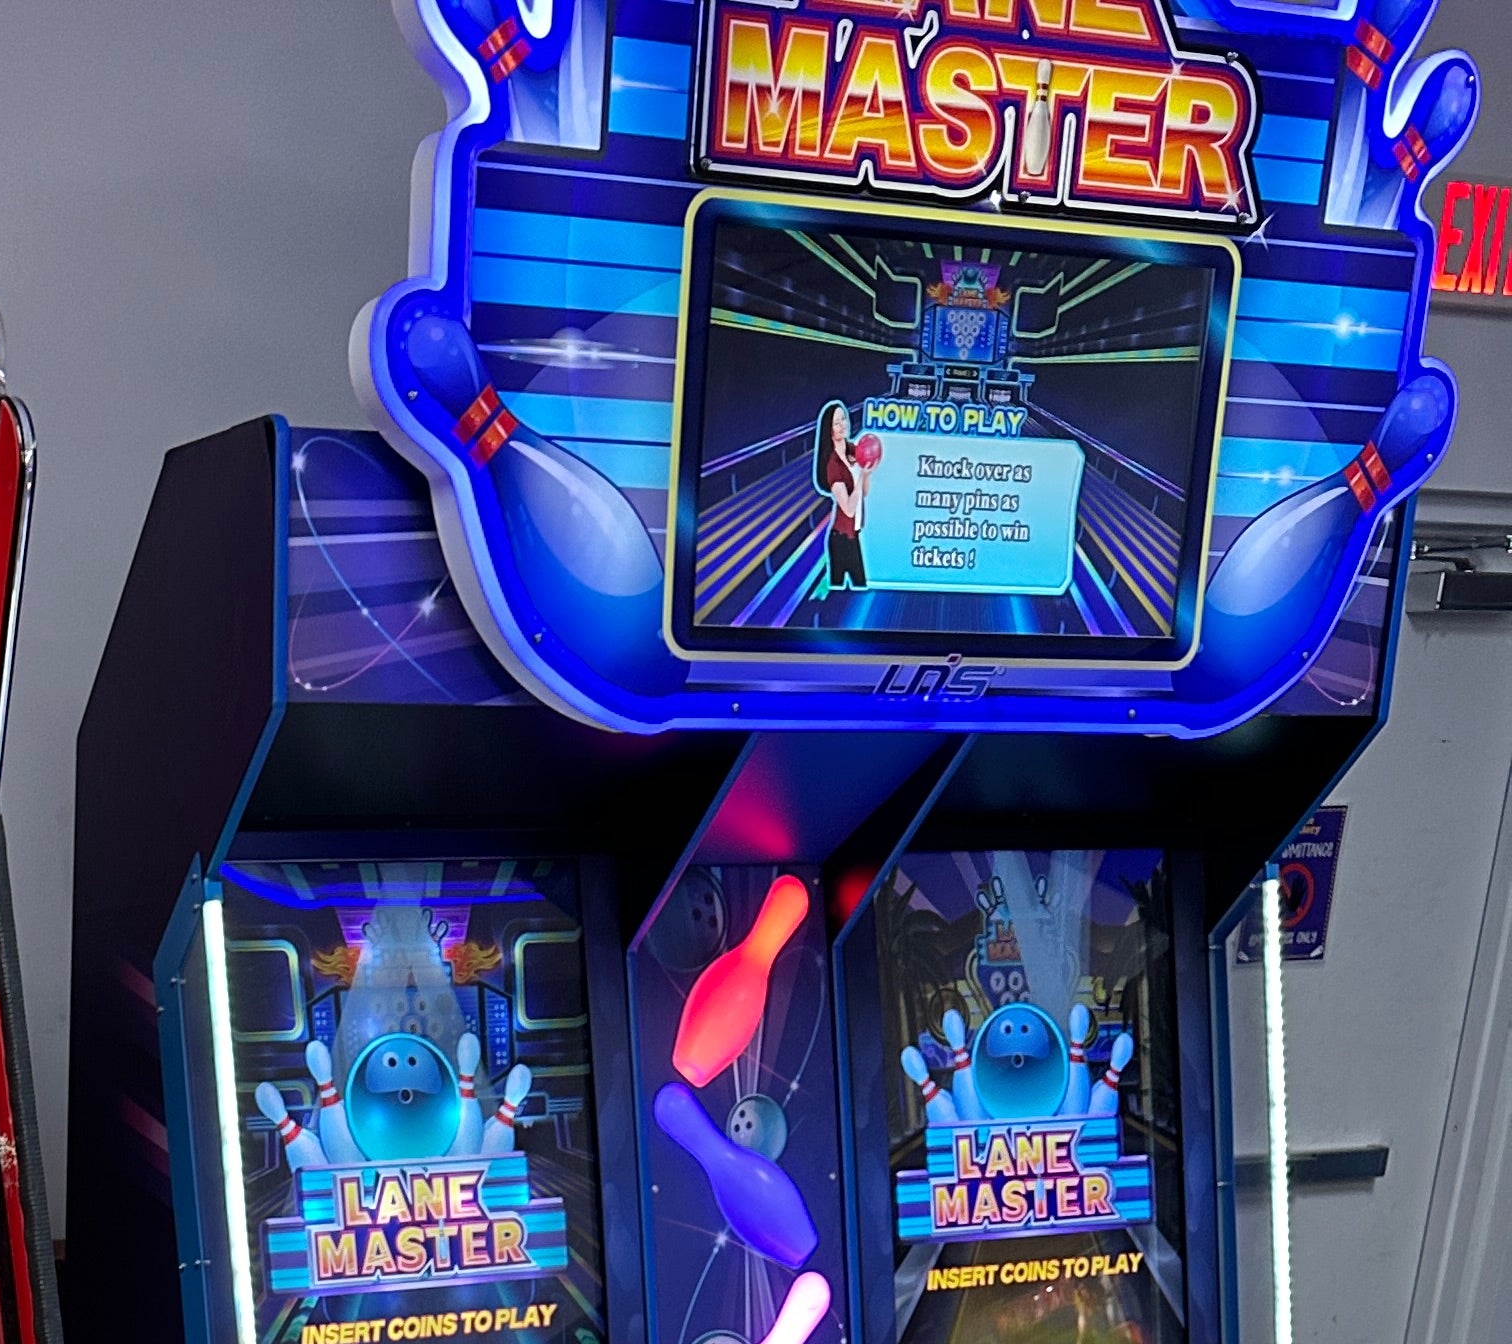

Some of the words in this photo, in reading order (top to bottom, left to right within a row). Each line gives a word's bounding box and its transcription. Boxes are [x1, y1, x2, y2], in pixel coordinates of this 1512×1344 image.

[720, 17, 1245, 203] MASTER
[1430, 181, 1512, 296] EXI
[865, 403, 919, 431] HOW
[925, 405, 957, 432] TO
[963, 408, 1025, 437] PLAY
[918, 455, 974, 479] Knock
[975, 464, 1011, 481] over
[1013, 465, 1032, 482] as
[916, 491, 961, 514] many
[964, 489, 998, 515] pins
[1001, 494, 1019, 512] as
[913, 518, 979, 543] possible
[982, 521, 997, 540] to
[1001, 521, 1030, 542] win
[912, 547, 965, 569] tickets
[957, 1132, 1075, 1180] LANE
[342, 1172, 483, 1227] LANE
[935, 1175, 1112, 1227] MASTER
[316, 1220, 528, 1280] MASTER
[927, 1264, 999, 1291] INSERT
[1000, 1258, 1061, 1285] COINS
[1063, 1257, 1089, 1279] TO
[1090, 1252, 1144, 1275] PLAY
[387, 1310, 458, 1341] COINS
[461, 1309, 492, 1335] TO
[494, 1303, 558, 1331] PLAY
